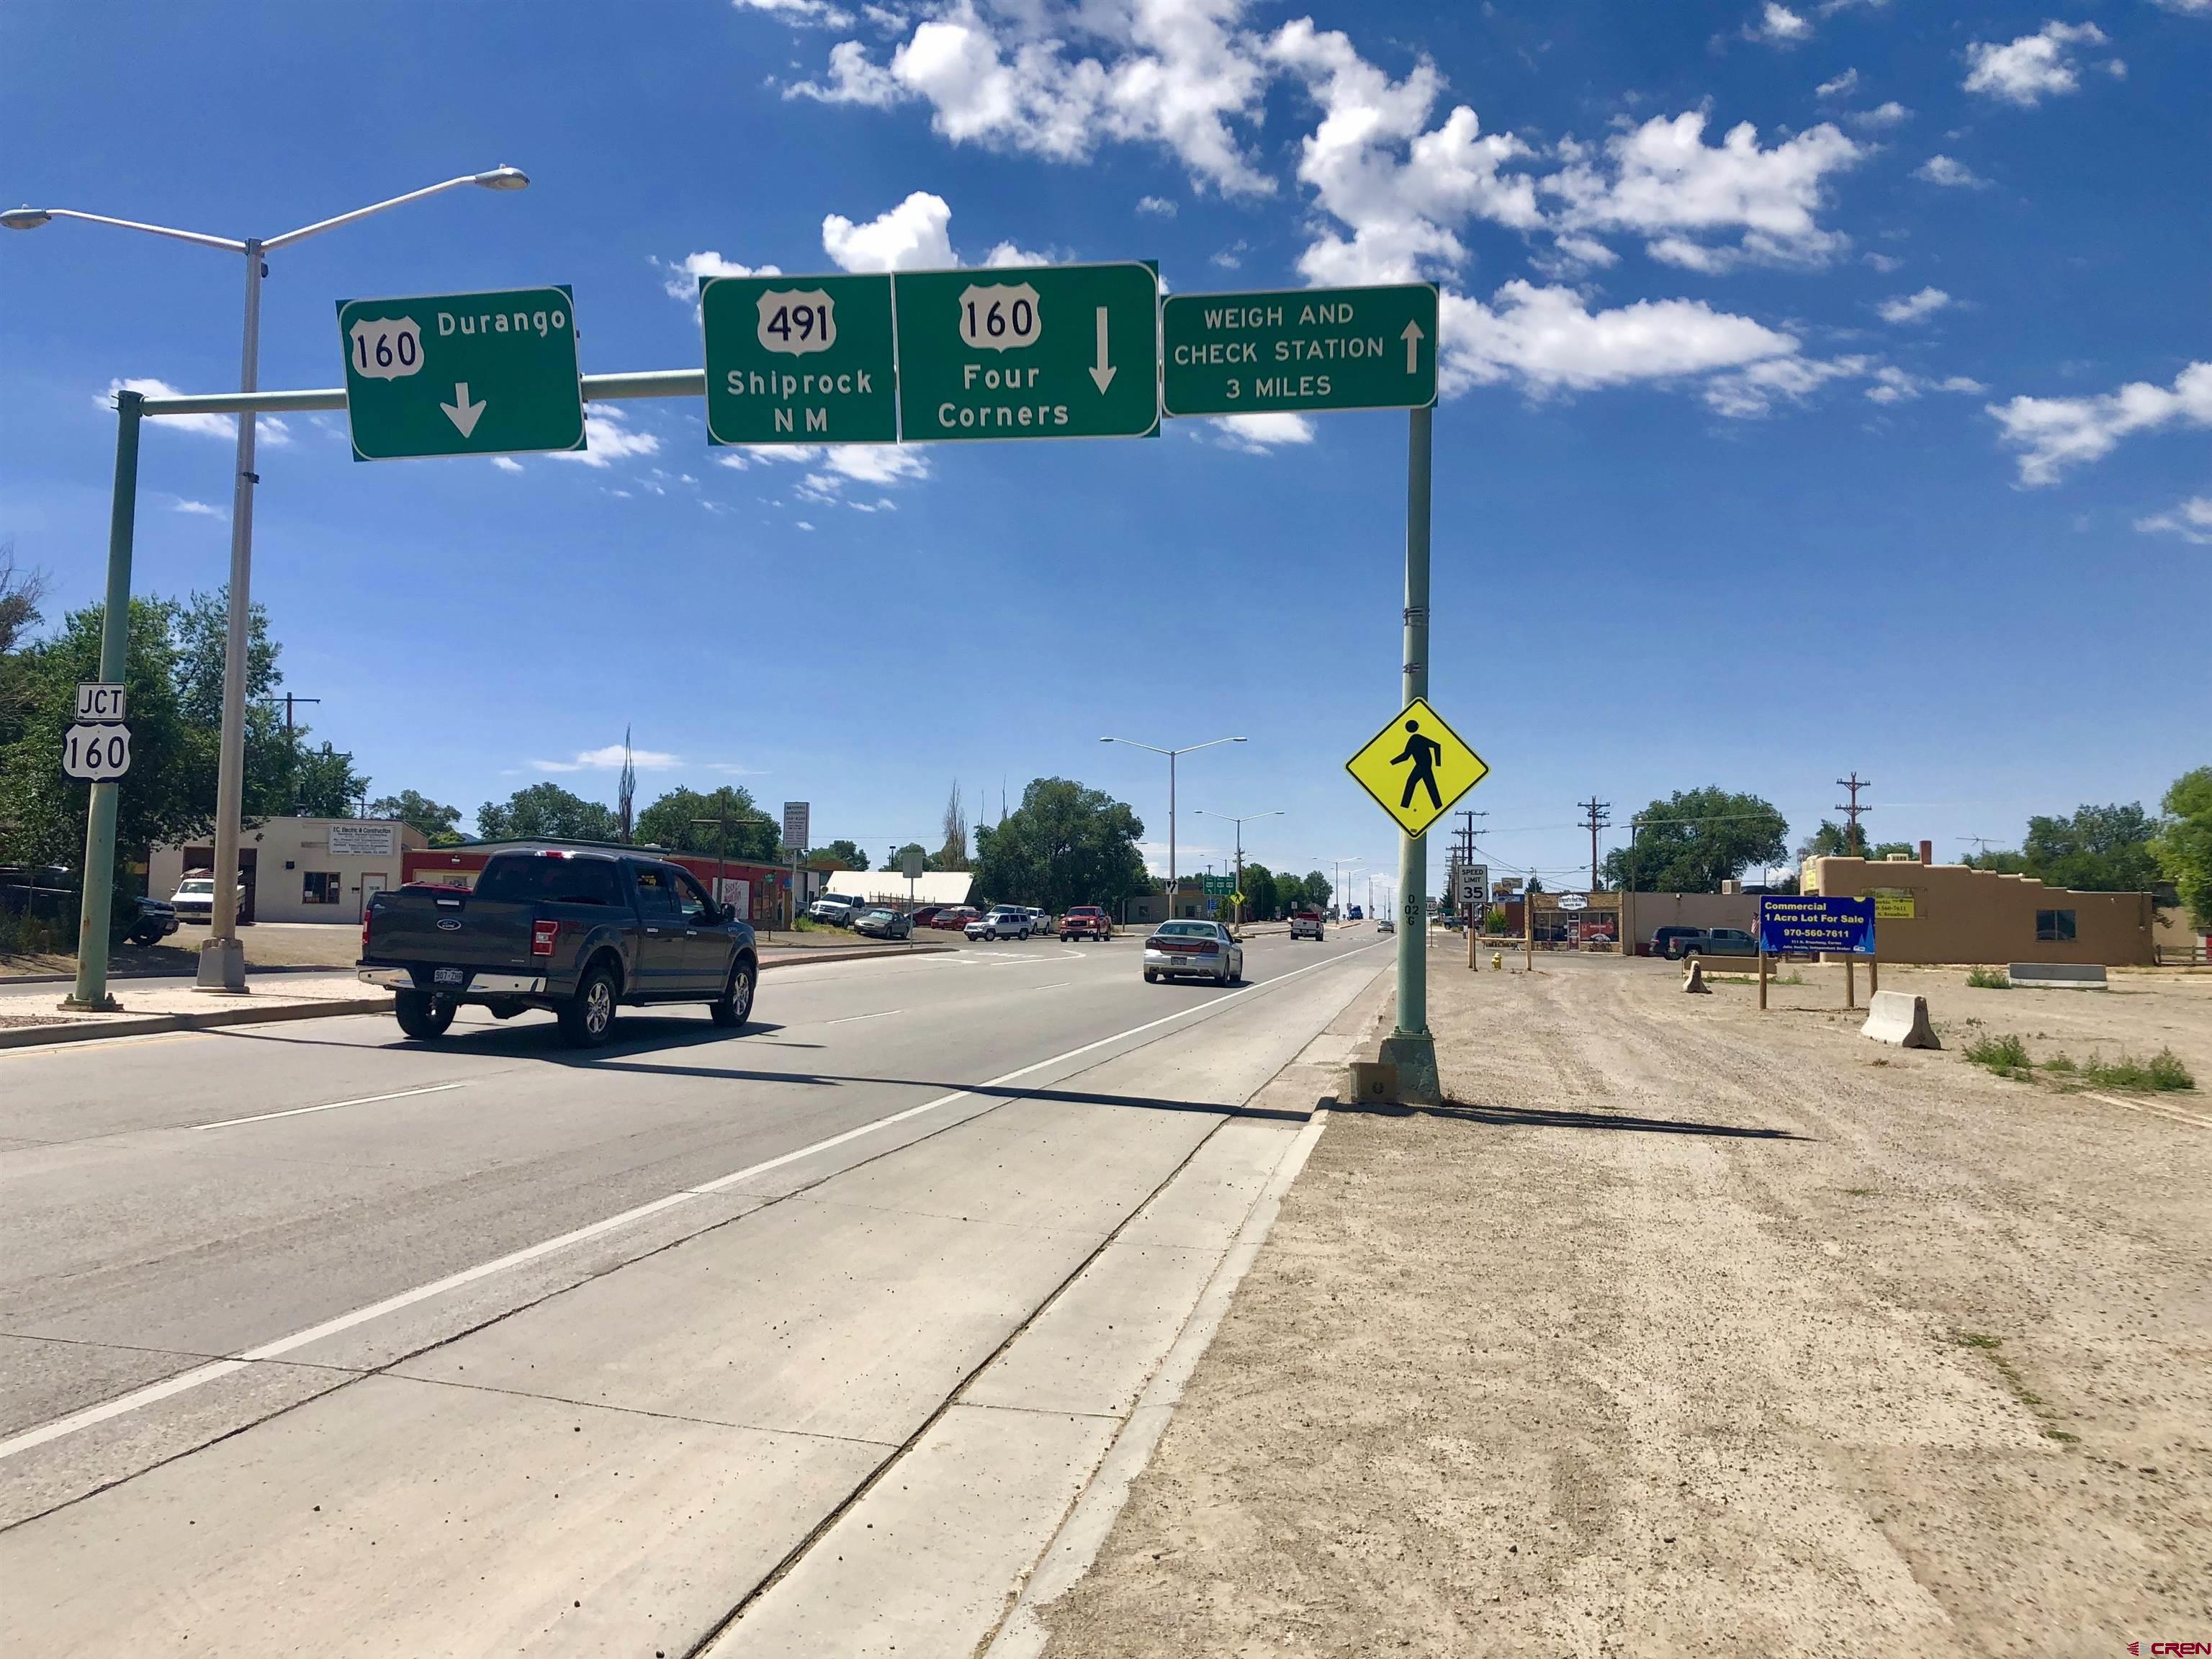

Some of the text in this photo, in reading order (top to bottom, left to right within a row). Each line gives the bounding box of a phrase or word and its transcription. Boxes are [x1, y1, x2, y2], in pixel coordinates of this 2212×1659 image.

[437, 310, 566, 338] Durango
[766, 305, 829, 342] 491
[967, 299, 1033, 338] 160
[1204, 303, 1354, 329] WEIGH AND
[357, 331, 416, 369] 160
[1174, 337, 1383, 365] CHECK STATION
[726, 369, 873, 400] Shiprock
[963, 364, 1041, 390] Four
[1226, 375, 1331, 399] 3 MILES
[938, 403, 1069, 428] Corners
[80, 689, 122, 714] JCT
[71, 736, 125, 769] 160
[1463, 886, 1483, 899] 35
[1764, 902, 1827, 911] Commercial
[1764, 913, 1865, 924] 1 Acre Lot For Sale
[1784, 928, 1850, 938] 970-560-7611
